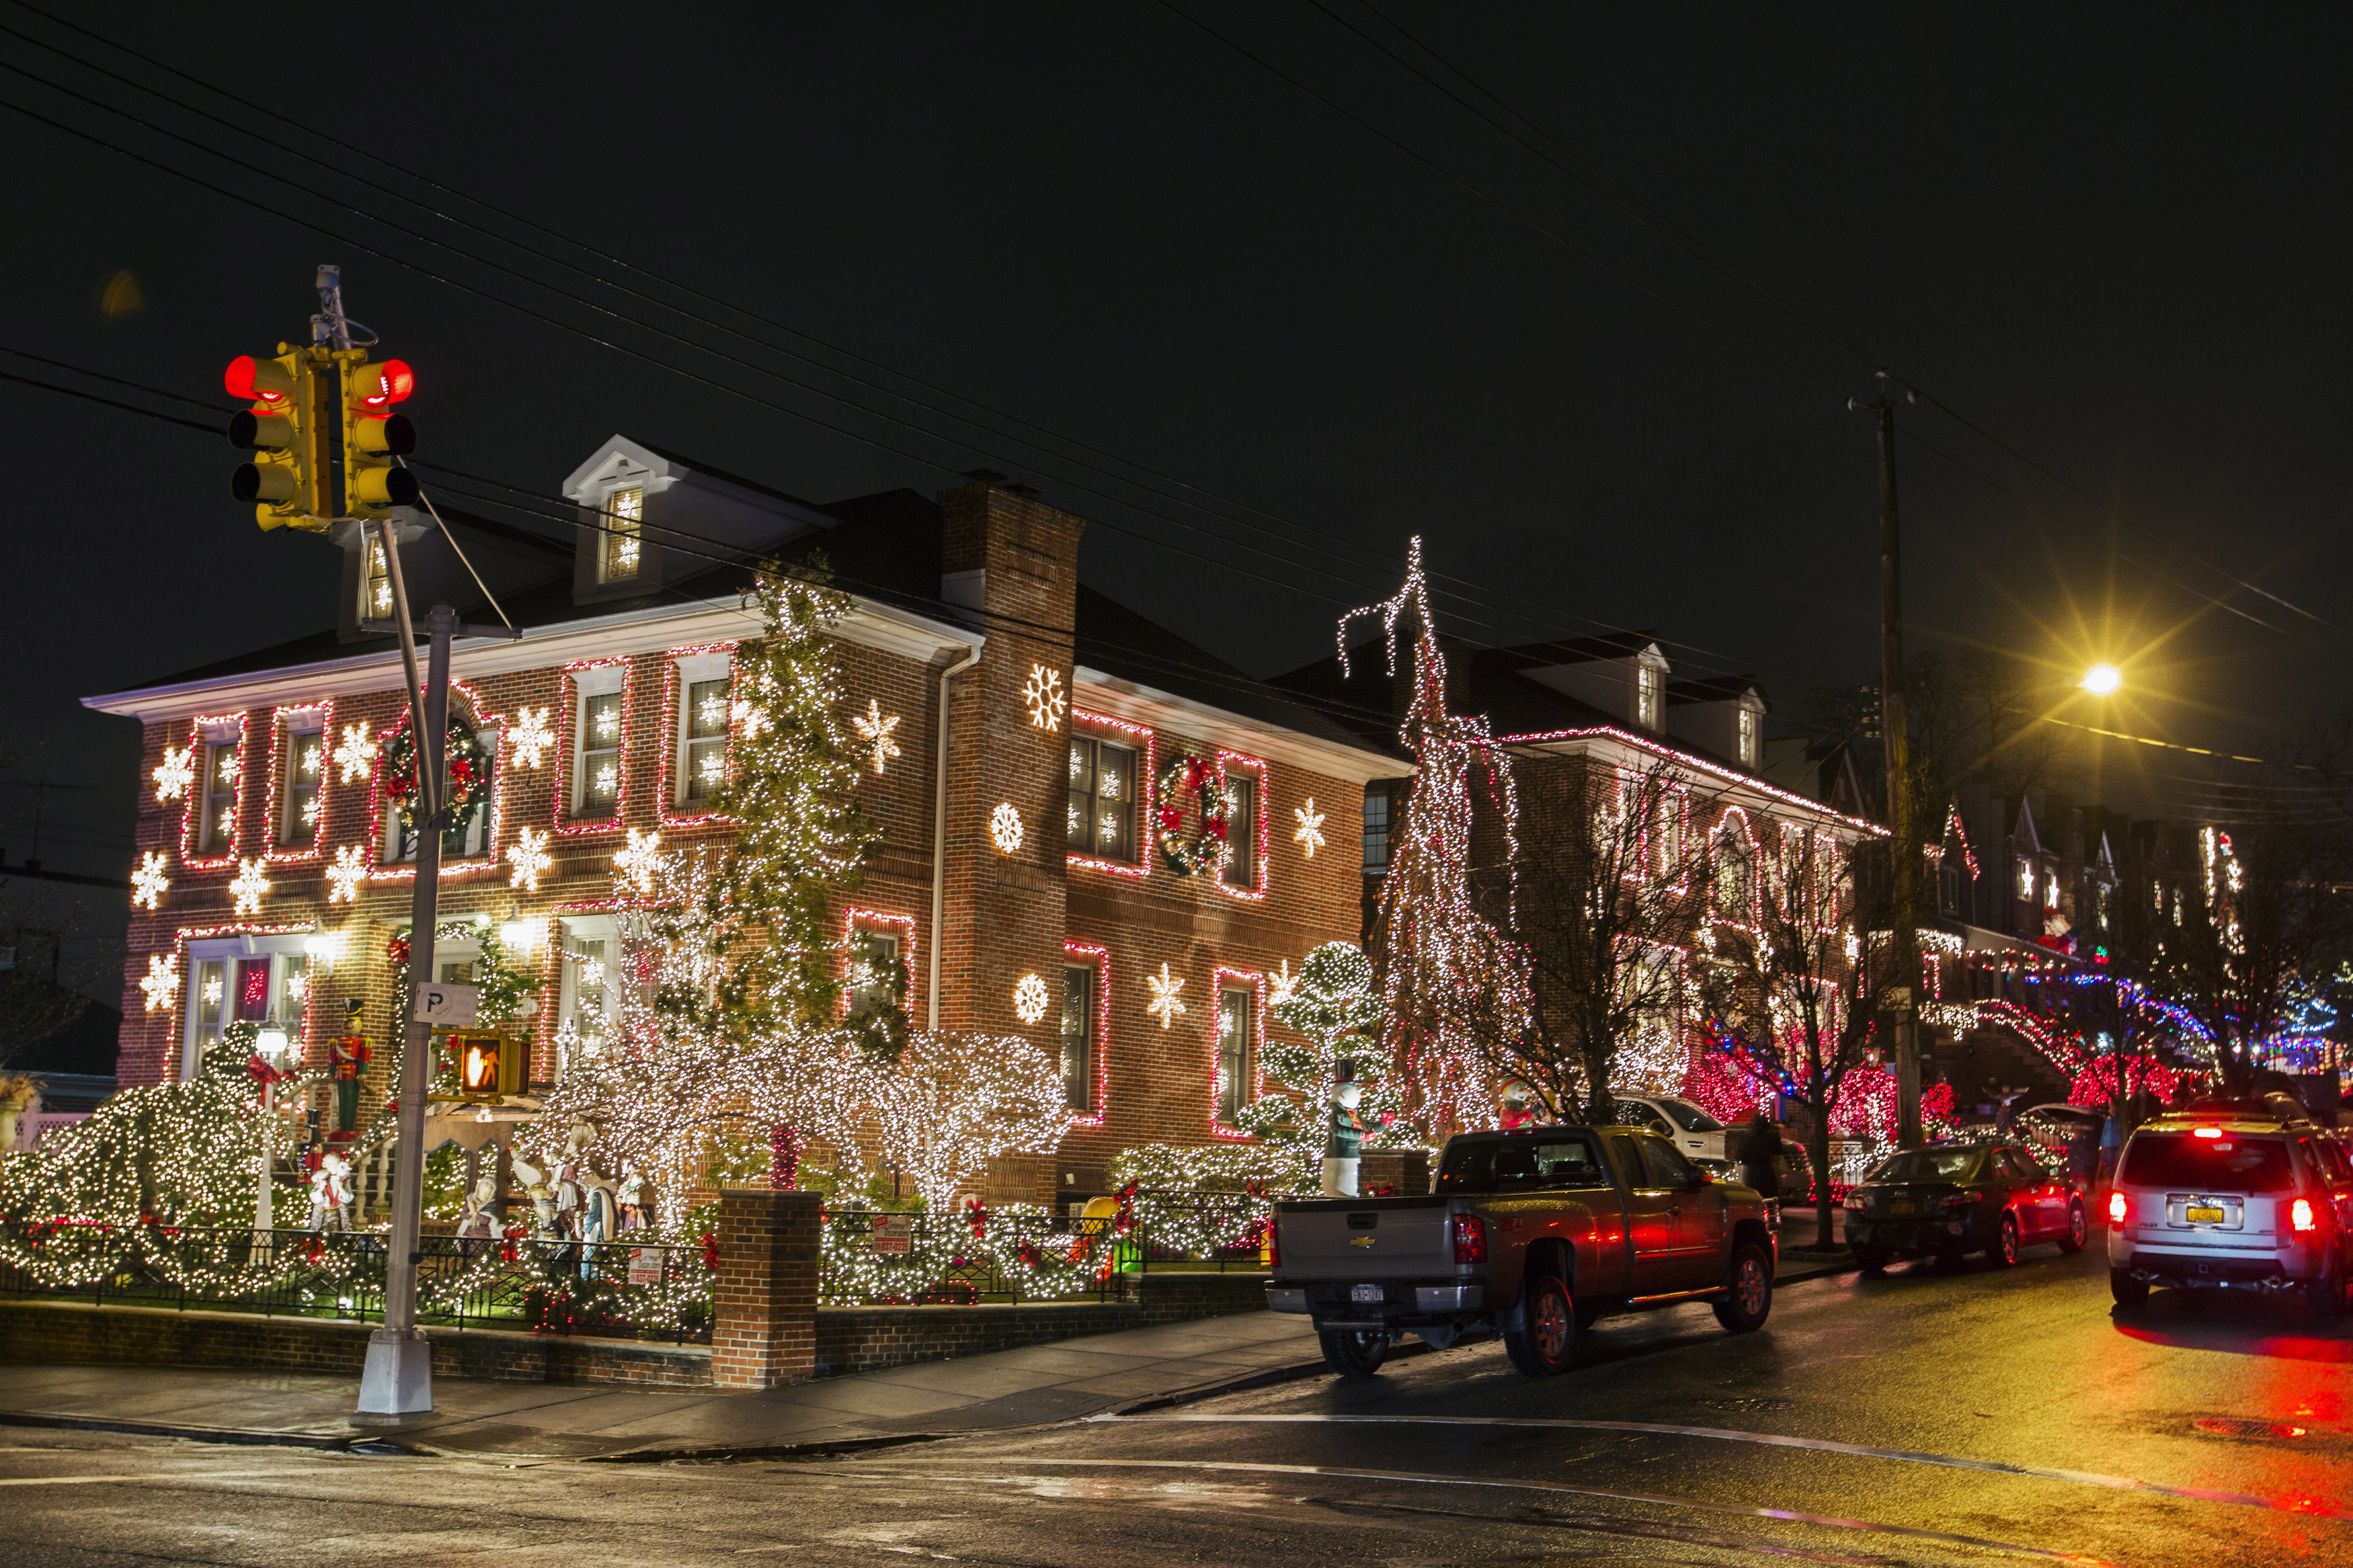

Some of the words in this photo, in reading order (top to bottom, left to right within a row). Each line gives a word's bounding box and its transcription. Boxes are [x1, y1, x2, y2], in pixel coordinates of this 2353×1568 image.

[427, 992, 443, 1013] P
[885, 1227, 908, 1237] Decorators
[881, 1242, 908, 1251] 837-0225
[639, 1258, 660, 1269] Decorators
